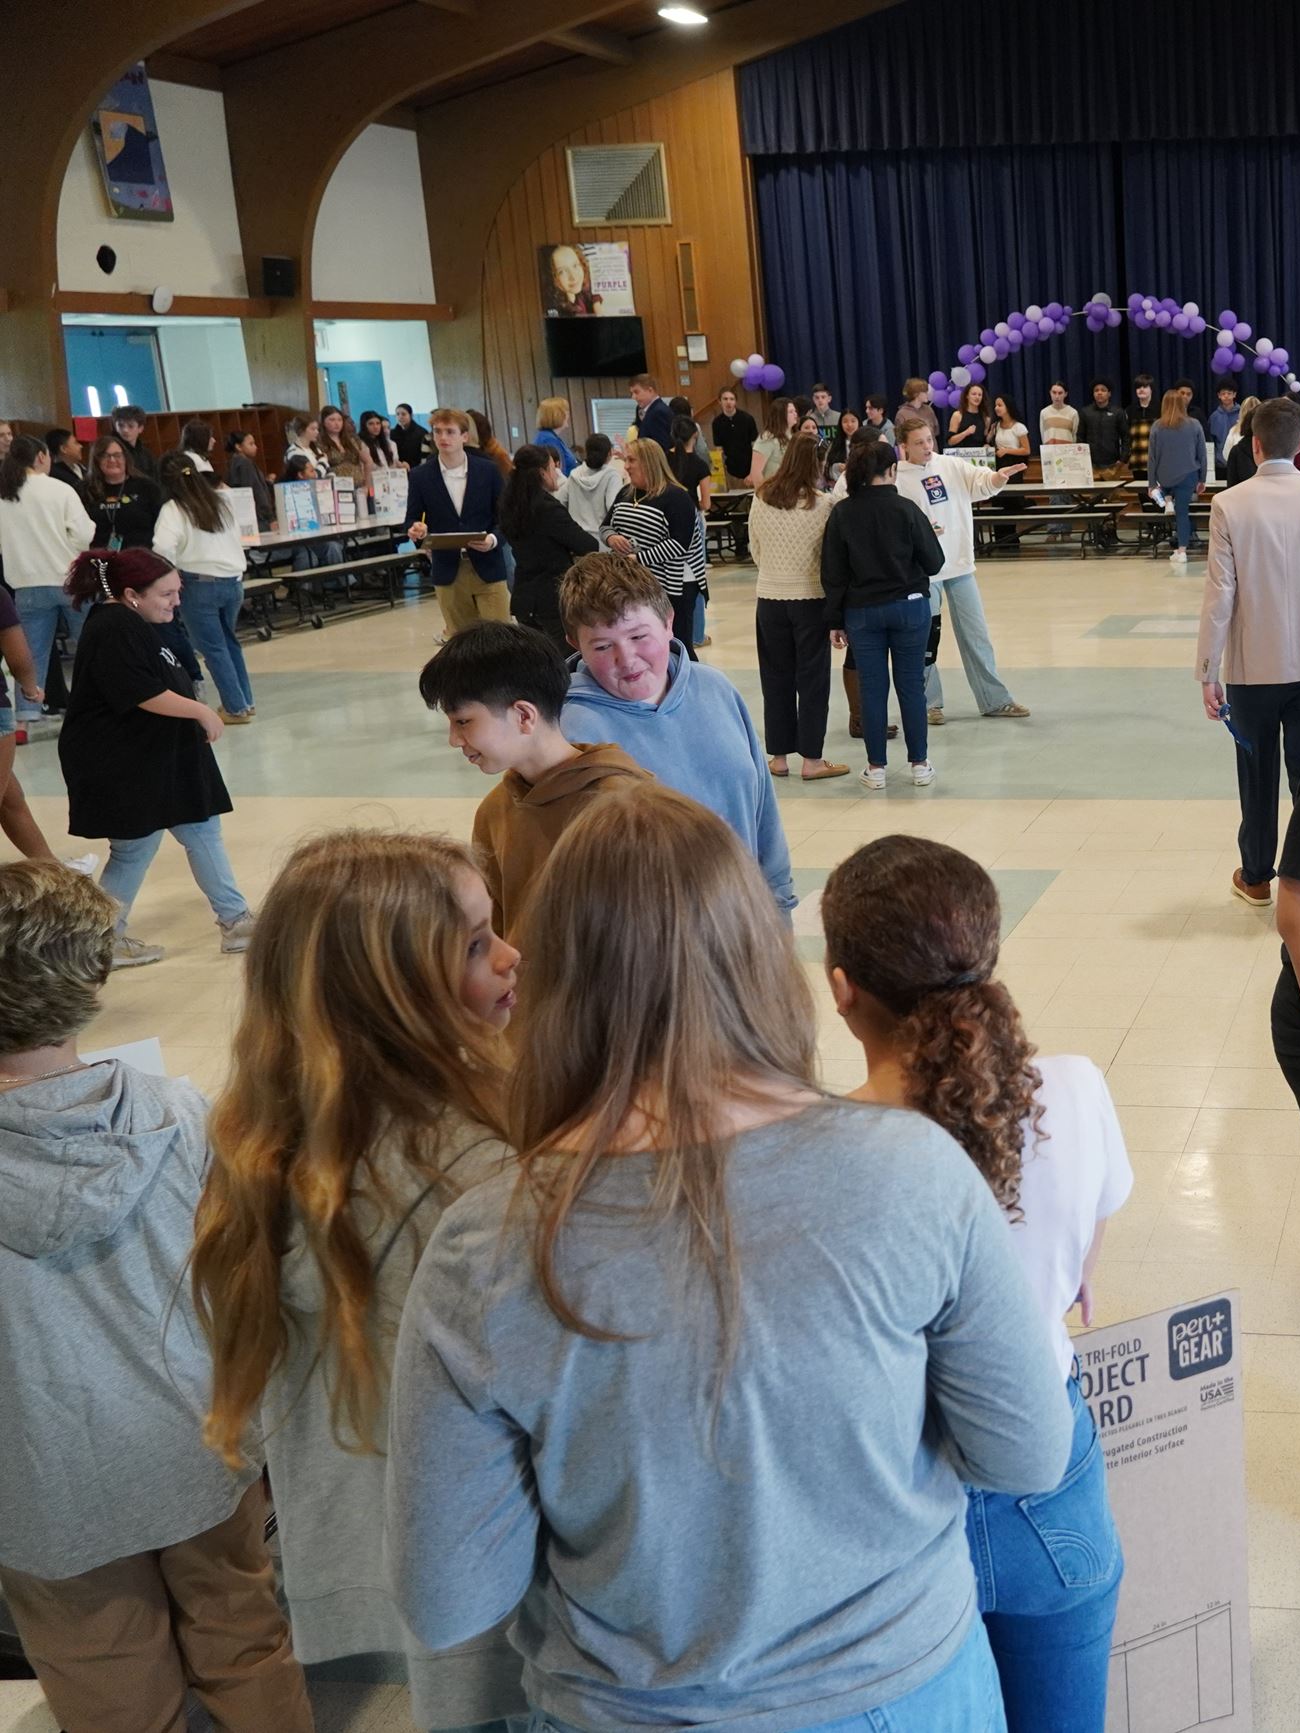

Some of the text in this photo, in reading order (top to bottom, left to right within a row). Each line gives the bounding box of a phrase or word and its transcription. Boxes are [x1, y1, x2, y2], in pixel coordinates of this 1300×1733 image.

[1085, 1338, 1142, 1367] TRI-FOLD
[1179, 1330, 1224, 1368] GEAR
[1200, 1388, 1222, 1402] USA
[1137, 1423, 1188, 1447] Construction
[1121, 1450, 1152, 1466] Interior
[1155, 1437, 1185, 1456] Surface
